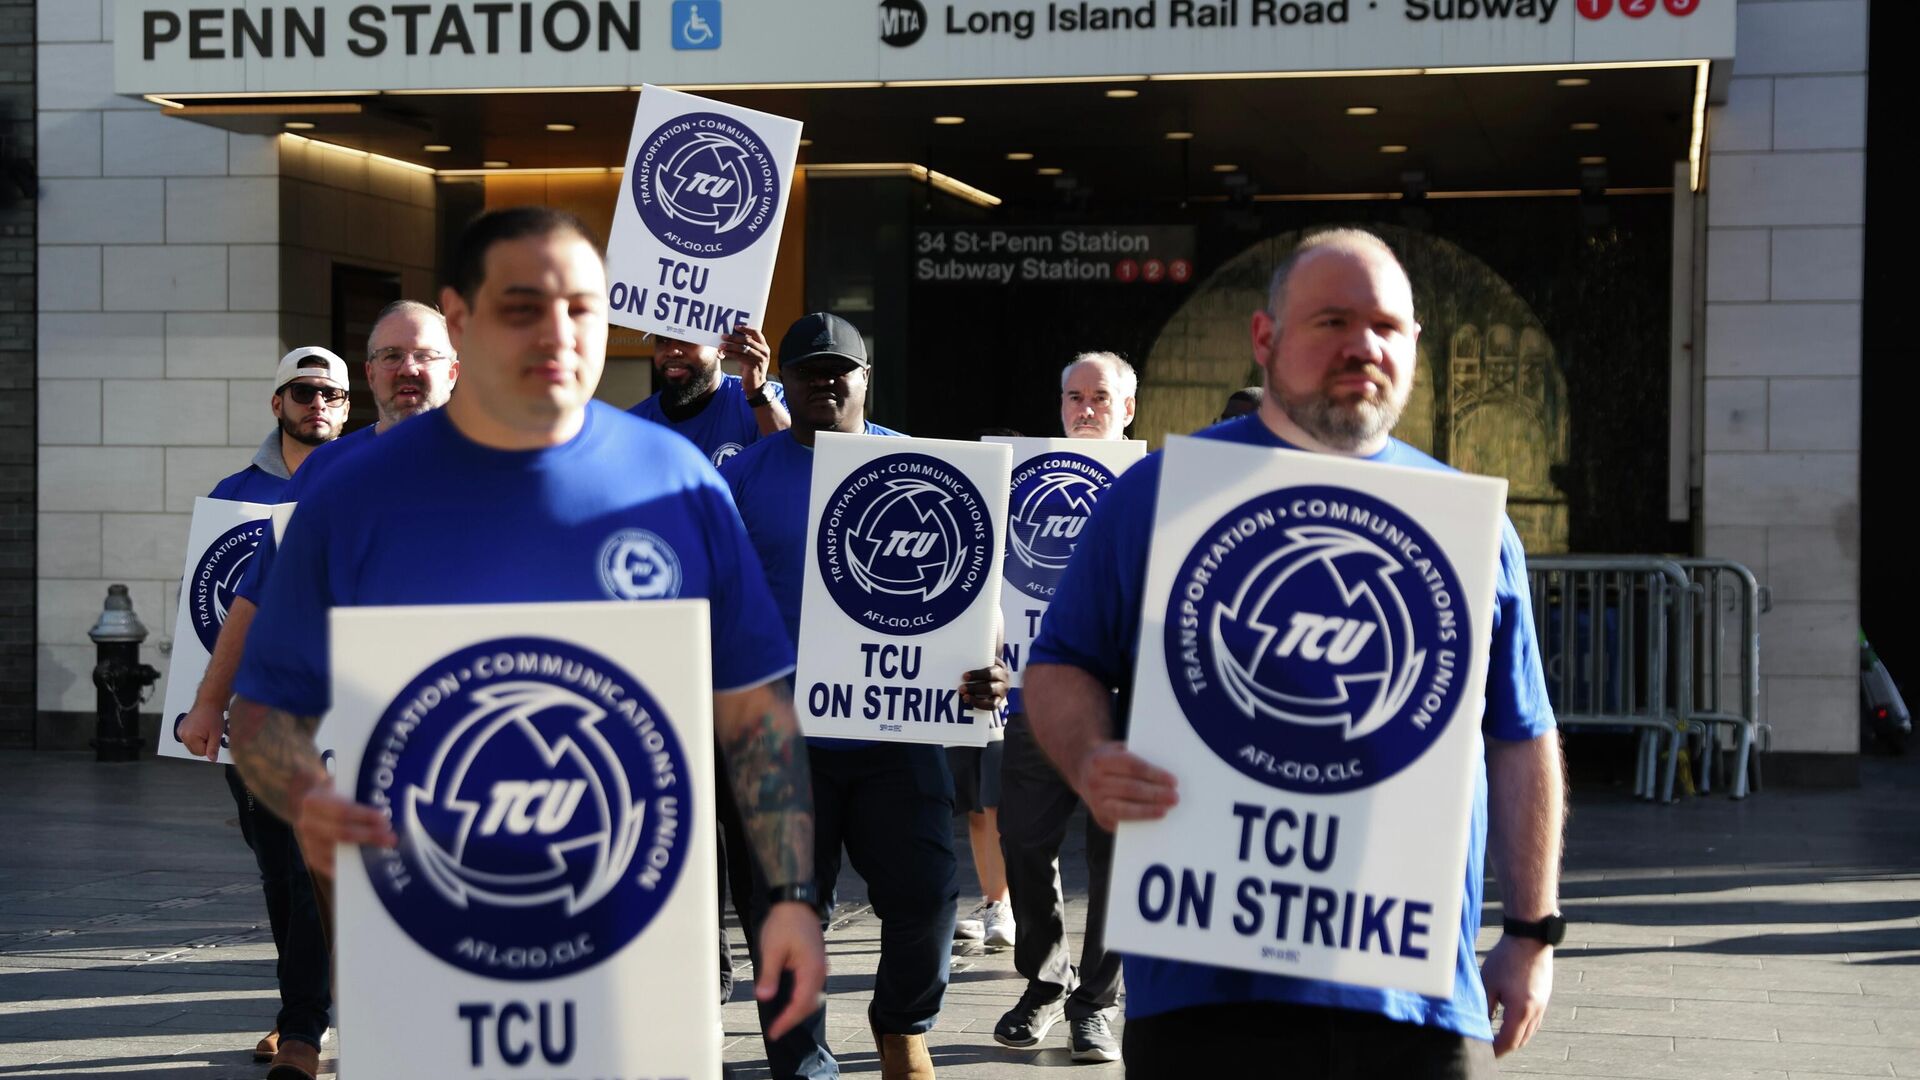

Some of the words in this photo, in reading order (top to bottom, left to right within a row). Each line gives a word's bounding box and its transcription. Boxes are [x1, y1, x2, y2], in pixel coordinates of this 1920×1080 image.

[143, 6, 326, 61] PENN
[347, 0, 641, 58] STATION
[880, 6, 920, 37] MTA
[945, 5, 1035, 40] Long
[1048, 0, 1157, 33] Island
[1169, 0, 1238, 29] Rail
[1251, 0, 1349, 27] Road
[1404, 0, 1559, 24] Subway
[640, 121, 691, 206] TRANSPORTATION
[699, 119, 773, 193] COMMUNICATIONS
[747, 196, 772, 233] UNION
[685, 171, 736, 198] TCU
[917, 231, 947, 252] 34
[953, 231, 1053, 253] St-Penn
[1060, 230, 1150, 252] Station
[658, 257, 710, 294] TCU
[917, 257, 1015, 284] Subway
[1022, 257, 1111, 280] Station
[609, 282, 649, 316] ON
[653, 292, 751, 336] STRIKE
[1043, 459, 1112, 491] COMMUNICA
[827, 470, 880, 584] TRANSPORTATION
[888, 462, 986, 540] COMMUNICATIONS
[961, 545, 985, 592] UNION
[882, 529, 940, 558] TCU
[1040, 515, 1089, 538] TCU
[198, 531, 248, 628] TRANSPORTATION
[1178, 508, 1277, 695] TRANSPORTATION
[1291, 499, 1457, 642] COMMUNICATIONS
[1410, 649, 1456, 730] UNION
[1275, 612, 1378, 665] TCU
[860, 643, 922, 680] TCU
[808, 682, 853, 718] ON
[862, 684, 975, 725] STRIKE
[474, 652, 677, 790] COMMUNICATIONS
[637, 796, 678, 890] UNION
[479, 779, 588, 835] TCU
[1232, 801, 1341, 874] TCU
[1136, 863, 1217, 931] ON
[1232, 876, 1434, 961] STRIKE
[457, 1001, 577, 1067] TCU
